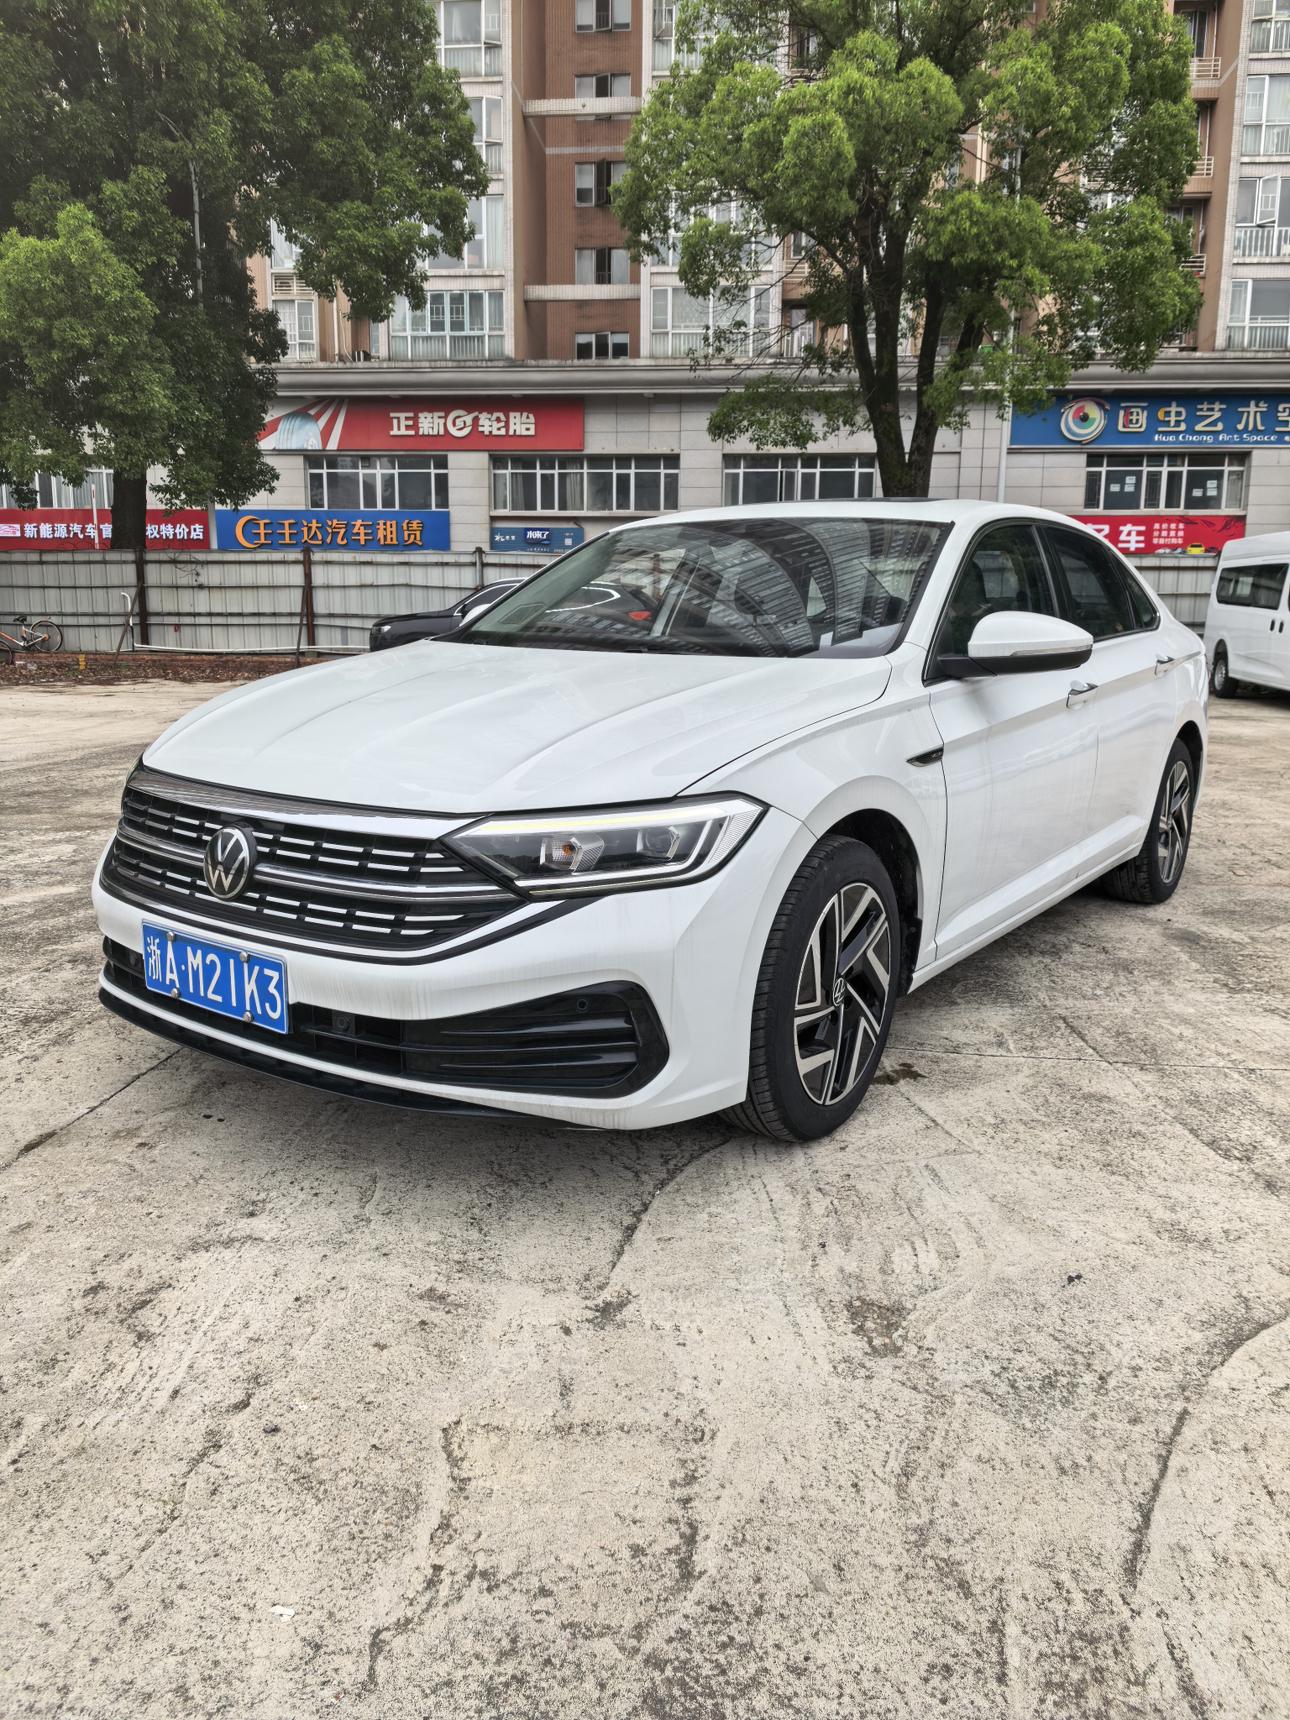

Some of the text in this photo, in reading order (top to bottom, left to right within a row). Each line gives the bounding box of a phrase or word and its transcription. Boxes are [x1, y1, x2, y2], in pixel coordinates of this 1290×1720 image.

[1154, 433, 1279, 444] Hua Chong Art Space
[24, 522, 205, 540] 新能源汽车官权特价店
